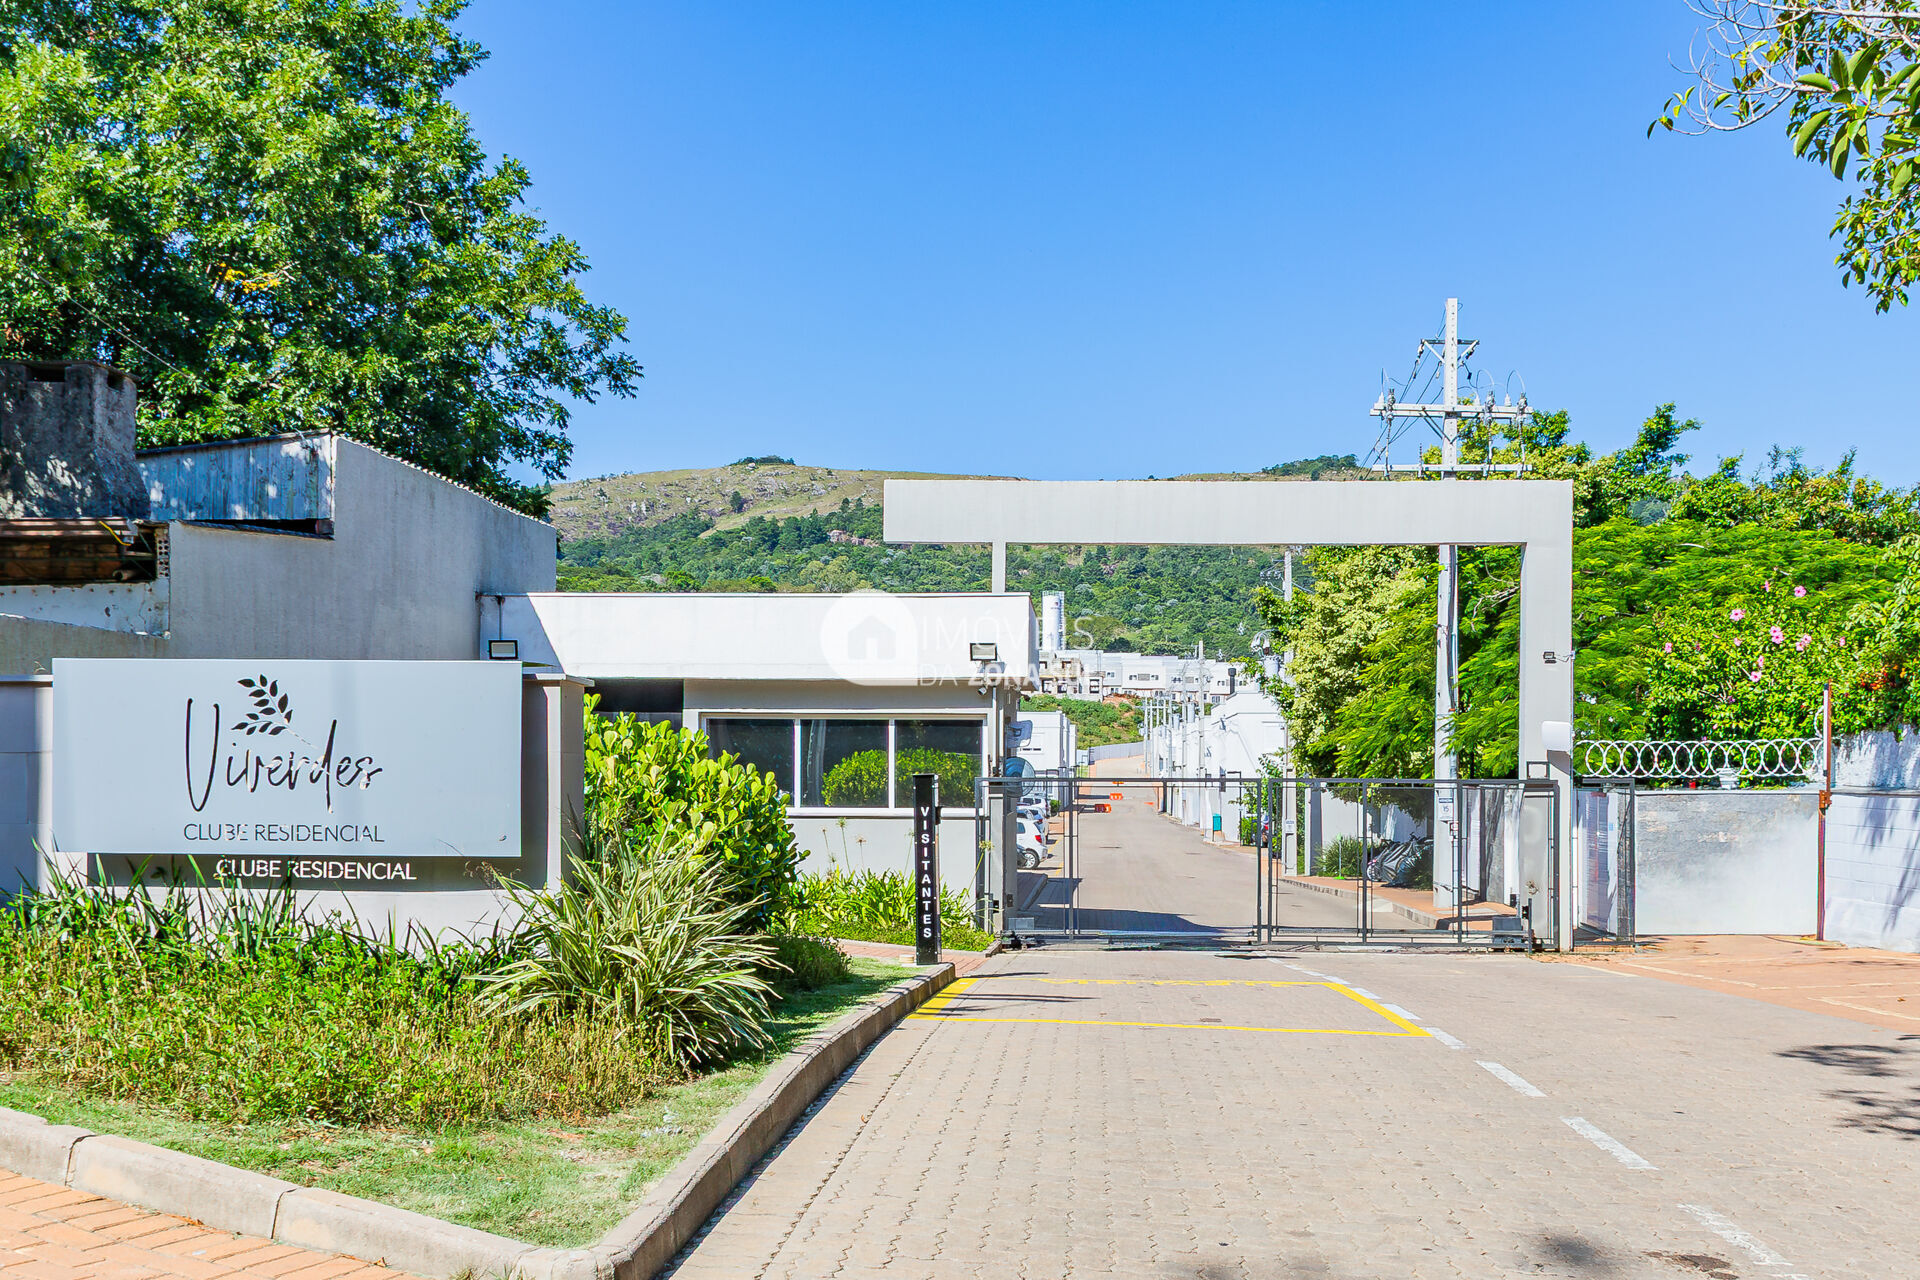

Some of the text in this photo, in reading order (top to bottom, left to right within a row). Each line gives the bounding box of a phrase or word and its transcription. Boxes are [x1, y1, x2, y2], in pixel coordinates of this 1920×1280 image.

[185, 697, 383, 814] Viverdes
[183, 823, 385, 843] CLUBE RESIDENCIAL
[216, 859, 417, 880] CLUBE RESIDENCIAL
[920, 806, 932, 938] VISITANTES
